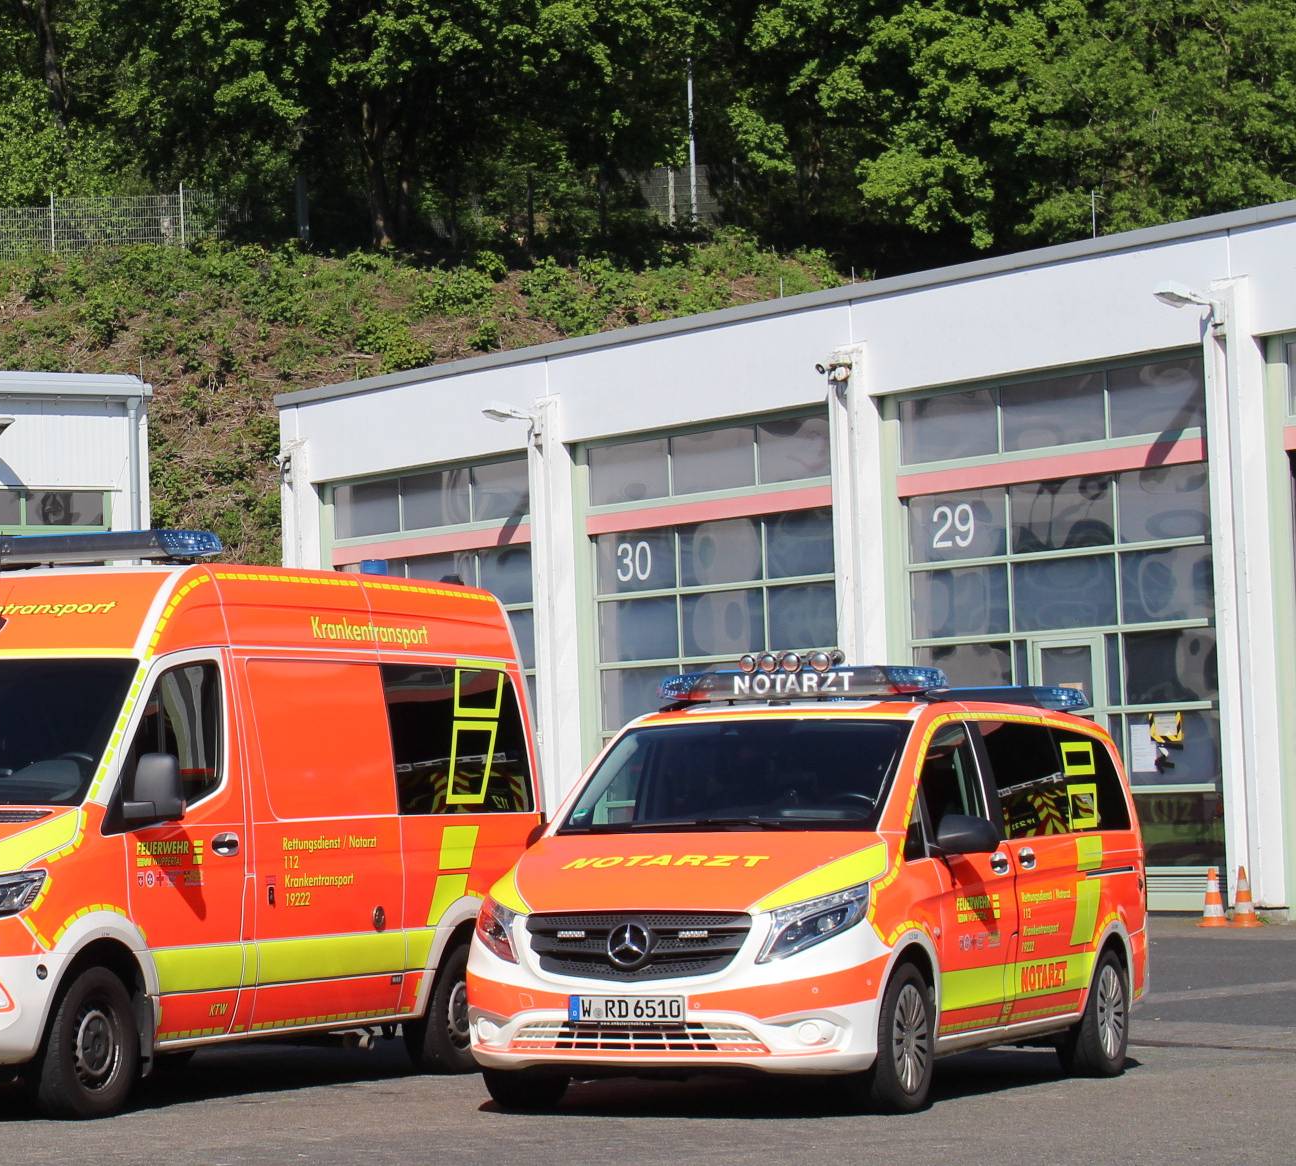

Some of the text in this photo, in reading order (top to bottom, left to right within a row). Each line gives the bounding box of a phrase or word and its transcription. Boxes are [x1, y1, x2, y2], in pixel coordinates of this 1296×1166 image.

[932, 503, 975, 549] 29
[616, 541, 652, 582] 30
[310, 615, 429, 649] Krankentransport
[733, 672, 854, 694] NOTARZT
[137, 841, 189, 856] FEUERWEHR
[282, 836, 340, 853] Rettungsdienst
[349, 835, 377, 848] Notarzt
[284, 855, 299, 869] 112
[561, 855, 770, 870] NOTARZT
[284, 873, 354, 888] Krankentransport
[286, 892, 311, 906] 19222
[956, 895, 991, 911] FEUERWEHR
[1021, 961, 1068, 993] NOTARZT
[209, 1004, 228, 1017] KTW
[582, 999, 592, 1018] W
[605, 999, 629, 1018] RD
[633, 999, 681, 1018] 6510
